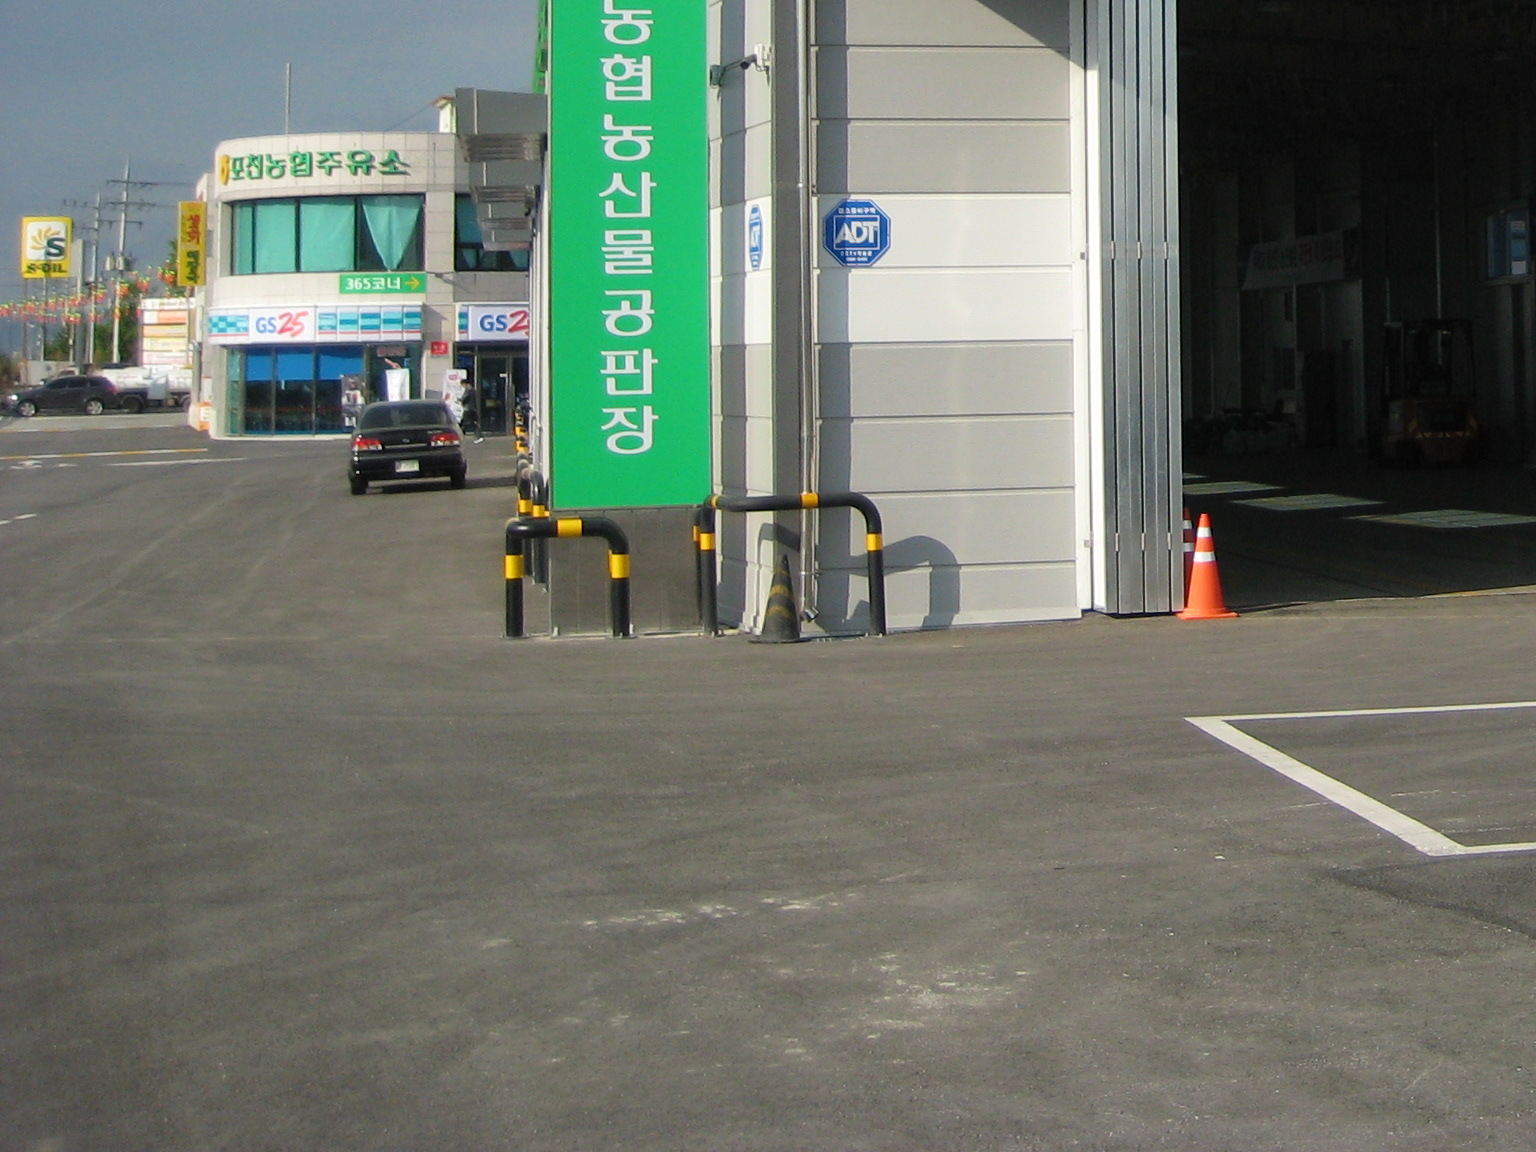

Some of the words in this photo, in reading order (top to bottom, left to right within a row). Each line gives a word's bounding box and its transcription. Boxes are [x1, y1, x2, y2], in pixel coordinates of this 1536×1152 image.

[229, 149, 410, 180] 포천농협주유소
[835, 221, 879, 244] ADT
[26, 261, 67, 274] S-OIL
[345, 277, 401, 290] 365코너
[255, 311, 309, 337] GS25
